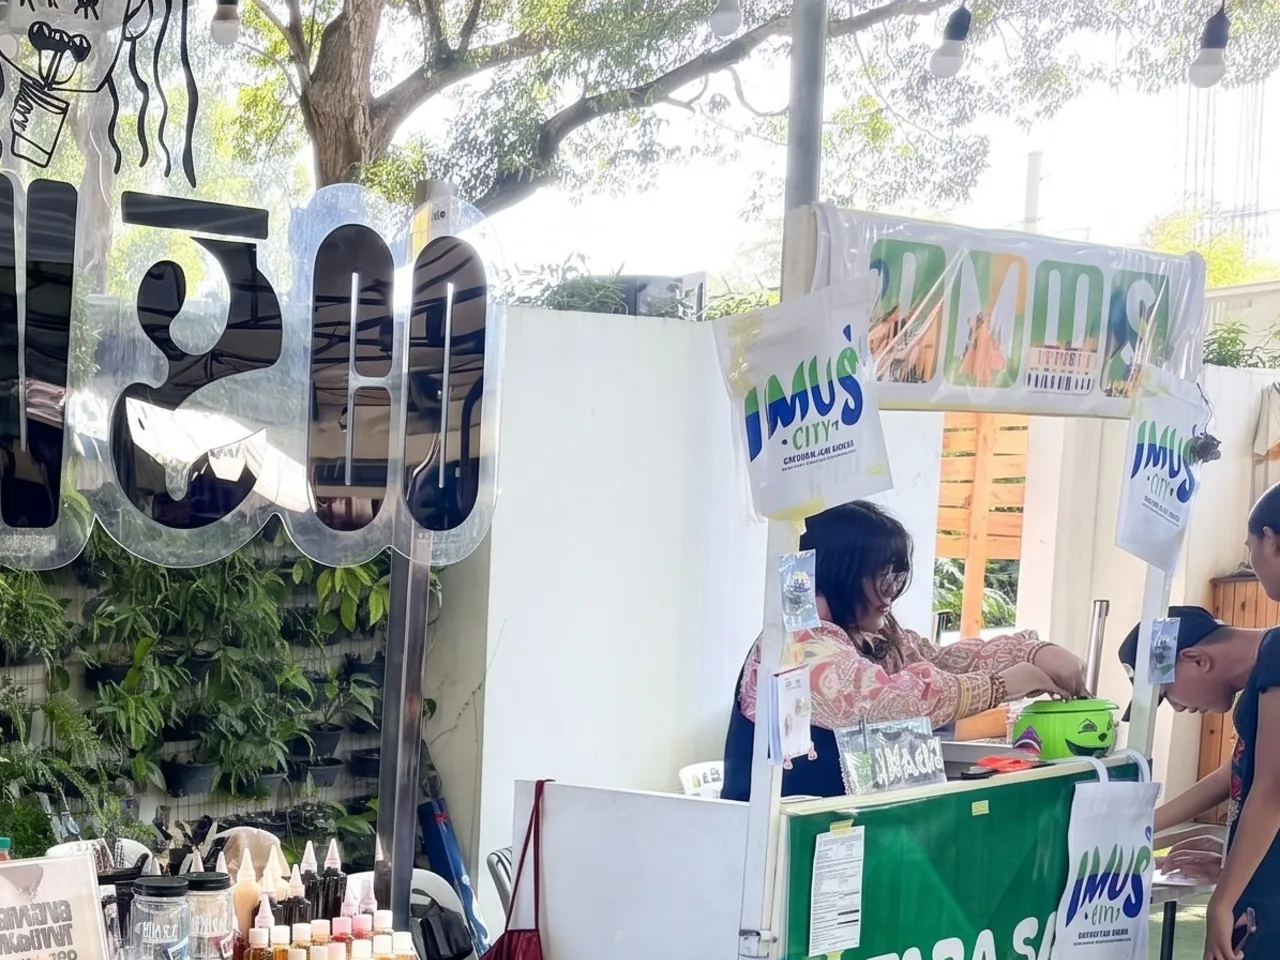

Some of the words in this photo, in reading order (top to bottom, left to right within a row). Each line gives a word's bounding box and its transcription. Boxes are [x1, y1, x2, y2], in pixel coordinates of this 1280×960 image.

[744, 324, 864, 463] IMUS
[1130, 420, 1197, 504] IMUS
[1065, 828, 1152, 928] IMUS
